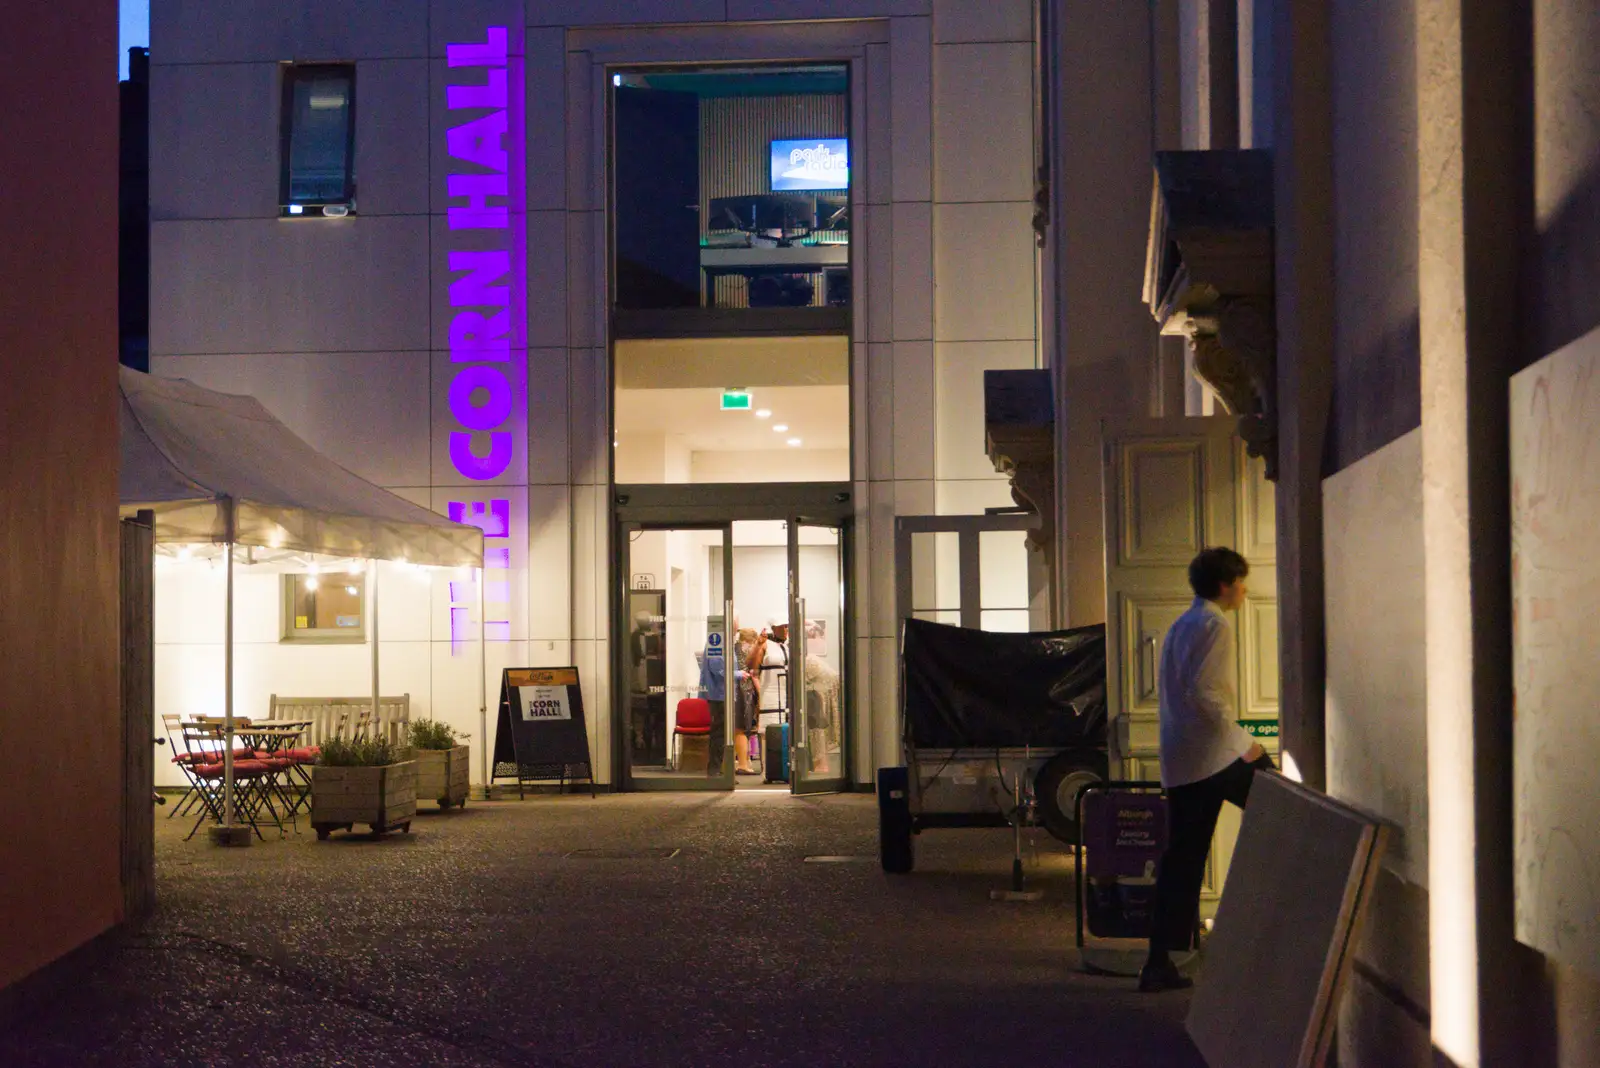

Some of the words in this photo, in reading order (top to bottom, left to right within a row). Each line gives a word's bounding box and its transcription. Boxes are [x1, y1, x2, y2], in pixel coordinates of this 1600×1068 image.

[446, 26, 509, 230] HALL
[790, 143, 830, 165] park
[448, 250, 513, 481] CORN
[533, 700, 560, 708] CORN
[530, 708, 558, 717] HALL
[1243, 724, 1256, 733] to
